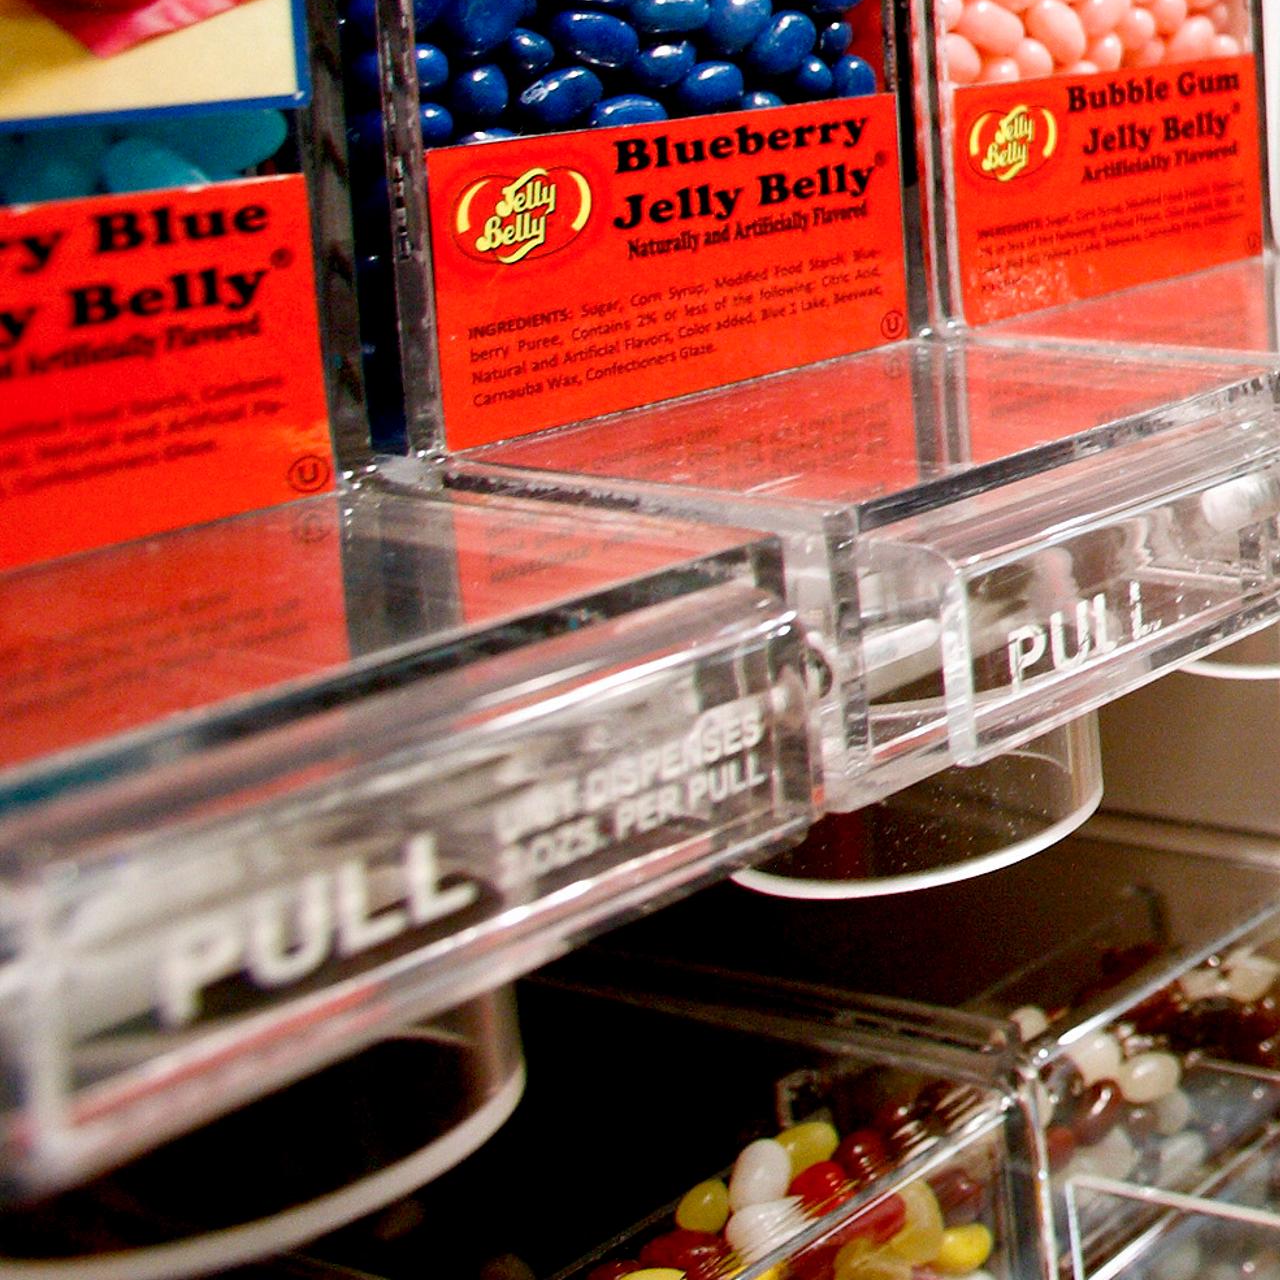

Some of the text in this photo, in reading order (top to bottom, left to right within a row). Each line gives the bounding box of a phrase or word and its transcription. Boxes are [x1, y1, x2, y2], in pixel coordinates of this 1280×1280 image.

[1066, 70, 1240, 113] Bubble Gum
[613, 117, 869, 174] Blueberry
[1082, 111, 1231, 156] Jelly Belly
[495, 167, 558, 218] Jelly
[612, 163, 876, 231] Jelly Belly
[94, 204, 269, 255] Blue
[475, 213, 548, 265] Belly
[627, 199, 868, 261] Naturally and Artificially Flavored
[69, 267, 270, 329] Belly
[467, 307, 573, 341] INGREDIENTS:
[580, 299, 624, 319] Sugar,
[630, 291, 662, 308] Corn
[470, 344, 509, 363] berry
[517, 334, 564, 353] Puree,
[571, 319, 631, 342] Contains
[637, 312, 657, 328] 2%
[664, 309, 677, 321] or
[683, 302, 709, 317] less
[714, 295, 728, 311] of
[733, 293, 753, 306] the
[471, 362, 527, 385] Natural
[531, 356, 559, 371] and
[563, 341, 619, 365] Artificial
[624, 331, 675, 351] Flavors,
[677, 320, 711, 338] Color
[472, 382, 544, 408] Carnauba
[546, 373, 583, 391] Wax,
[585, 349, 677, 382] Confectioners
[1007, 580, 1163, 694] PULL
[583, 704, 766, 814] DISPENSES
[613, 780, 686, 843] PER
[687, 748, 768, 816] PULL
[157, 830, 482, 1029] PULL
